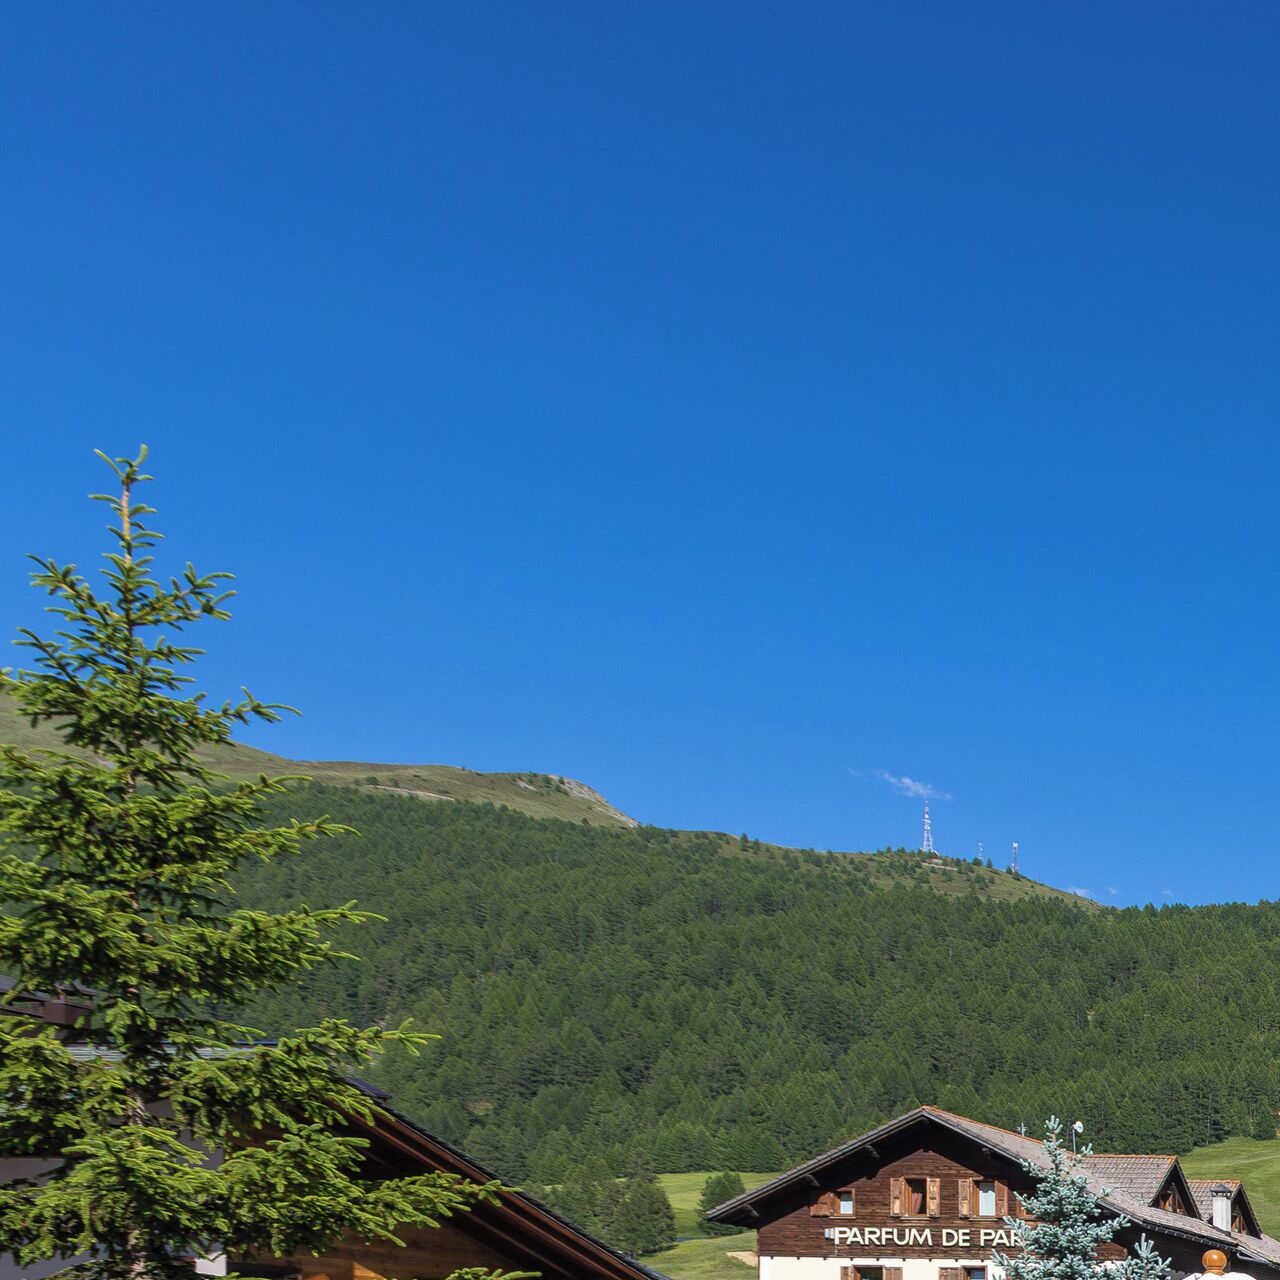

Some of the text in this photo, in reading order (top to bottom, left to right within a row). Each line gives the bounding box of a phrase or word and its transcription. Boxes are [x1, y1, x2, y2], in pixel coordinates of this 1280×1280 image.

[834, 1226, 1022, 1248] PARFUM DE PAR
